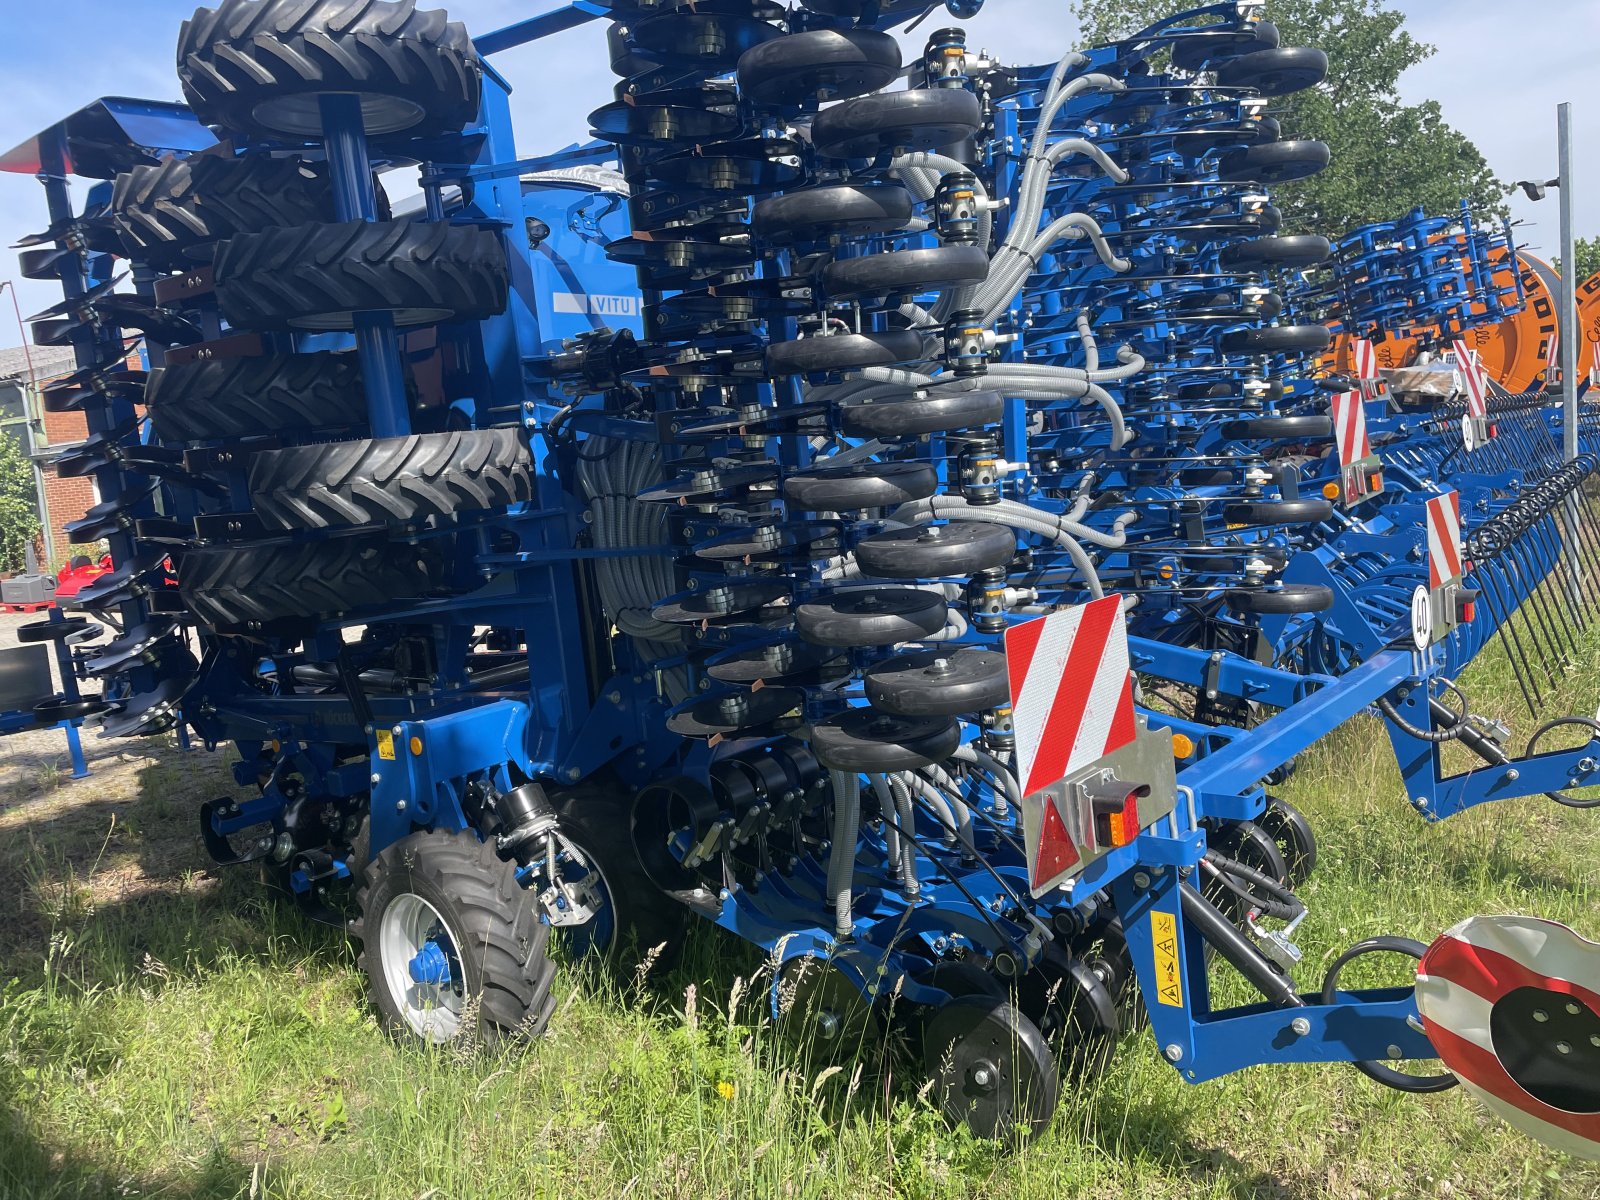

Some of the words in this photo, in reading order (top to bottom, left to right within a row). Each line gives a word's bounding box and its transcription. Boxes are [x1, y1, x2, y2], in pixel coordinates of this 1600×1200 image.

[596, 296, 630, 314] VITU
[1377, 346, 1395, 369] elle
[1416, 596, 1427, 637] 40
